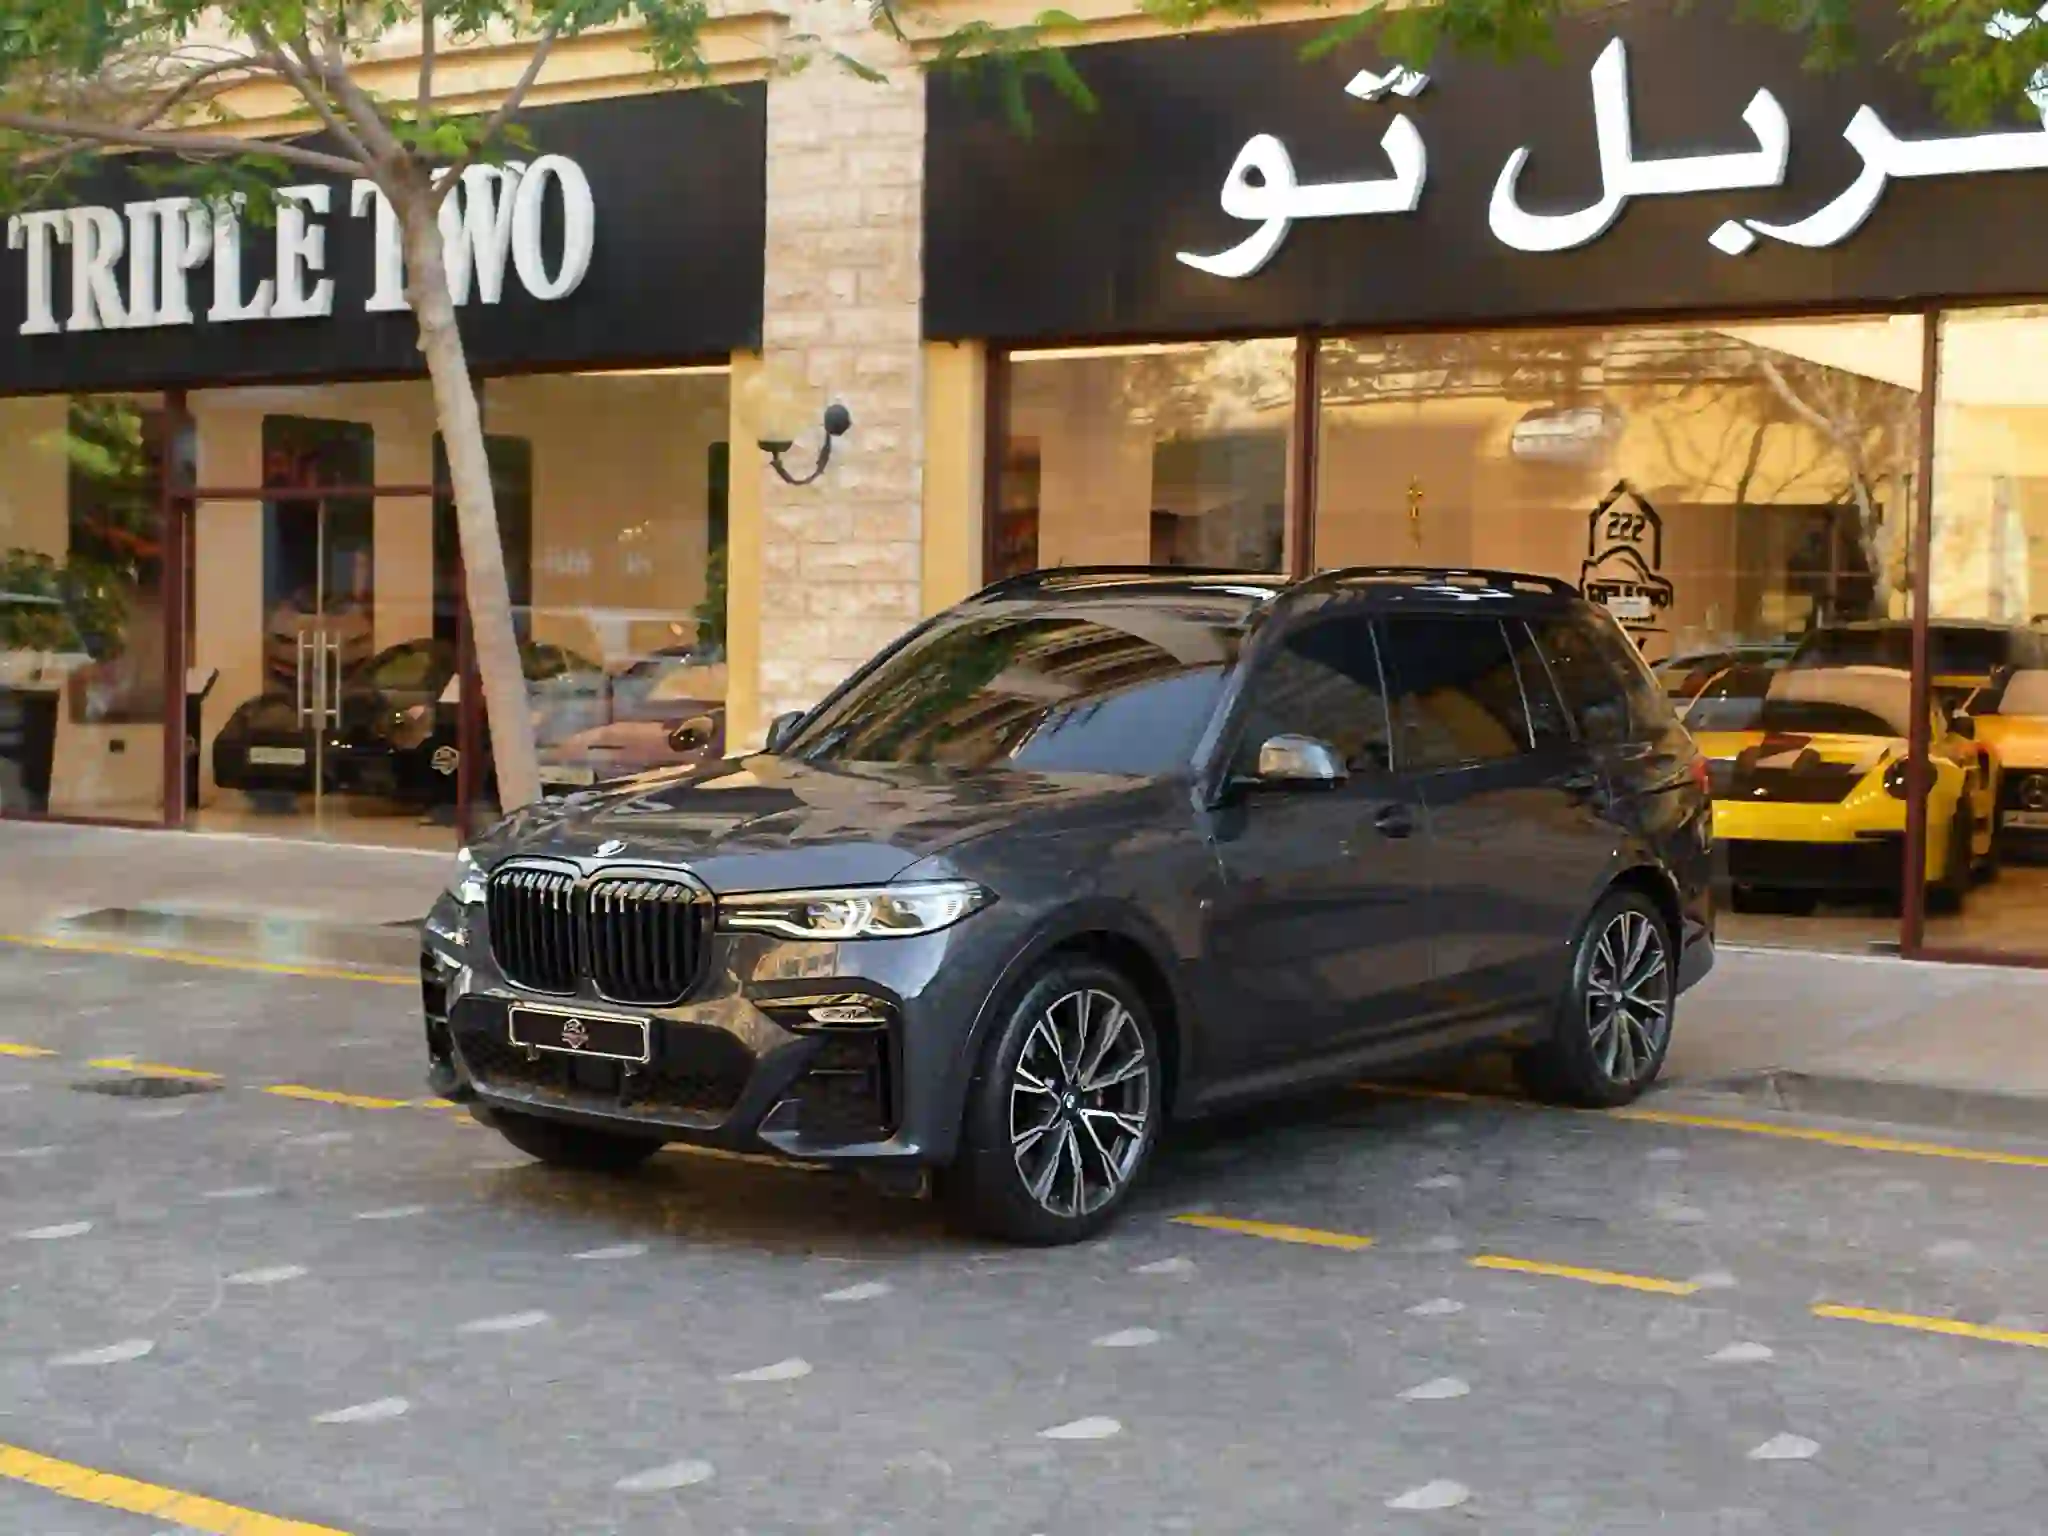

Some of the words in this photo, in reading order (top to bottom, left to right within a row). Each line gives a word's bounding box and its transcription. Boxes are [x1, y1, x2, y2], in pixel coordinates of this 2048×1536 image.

[8, 184, 335, 335] TRIPLE
[351, 153, 595, 312] TWO
[1176, 65, 1430, 278] تو
[1606, 511, 1646, 543] 222
